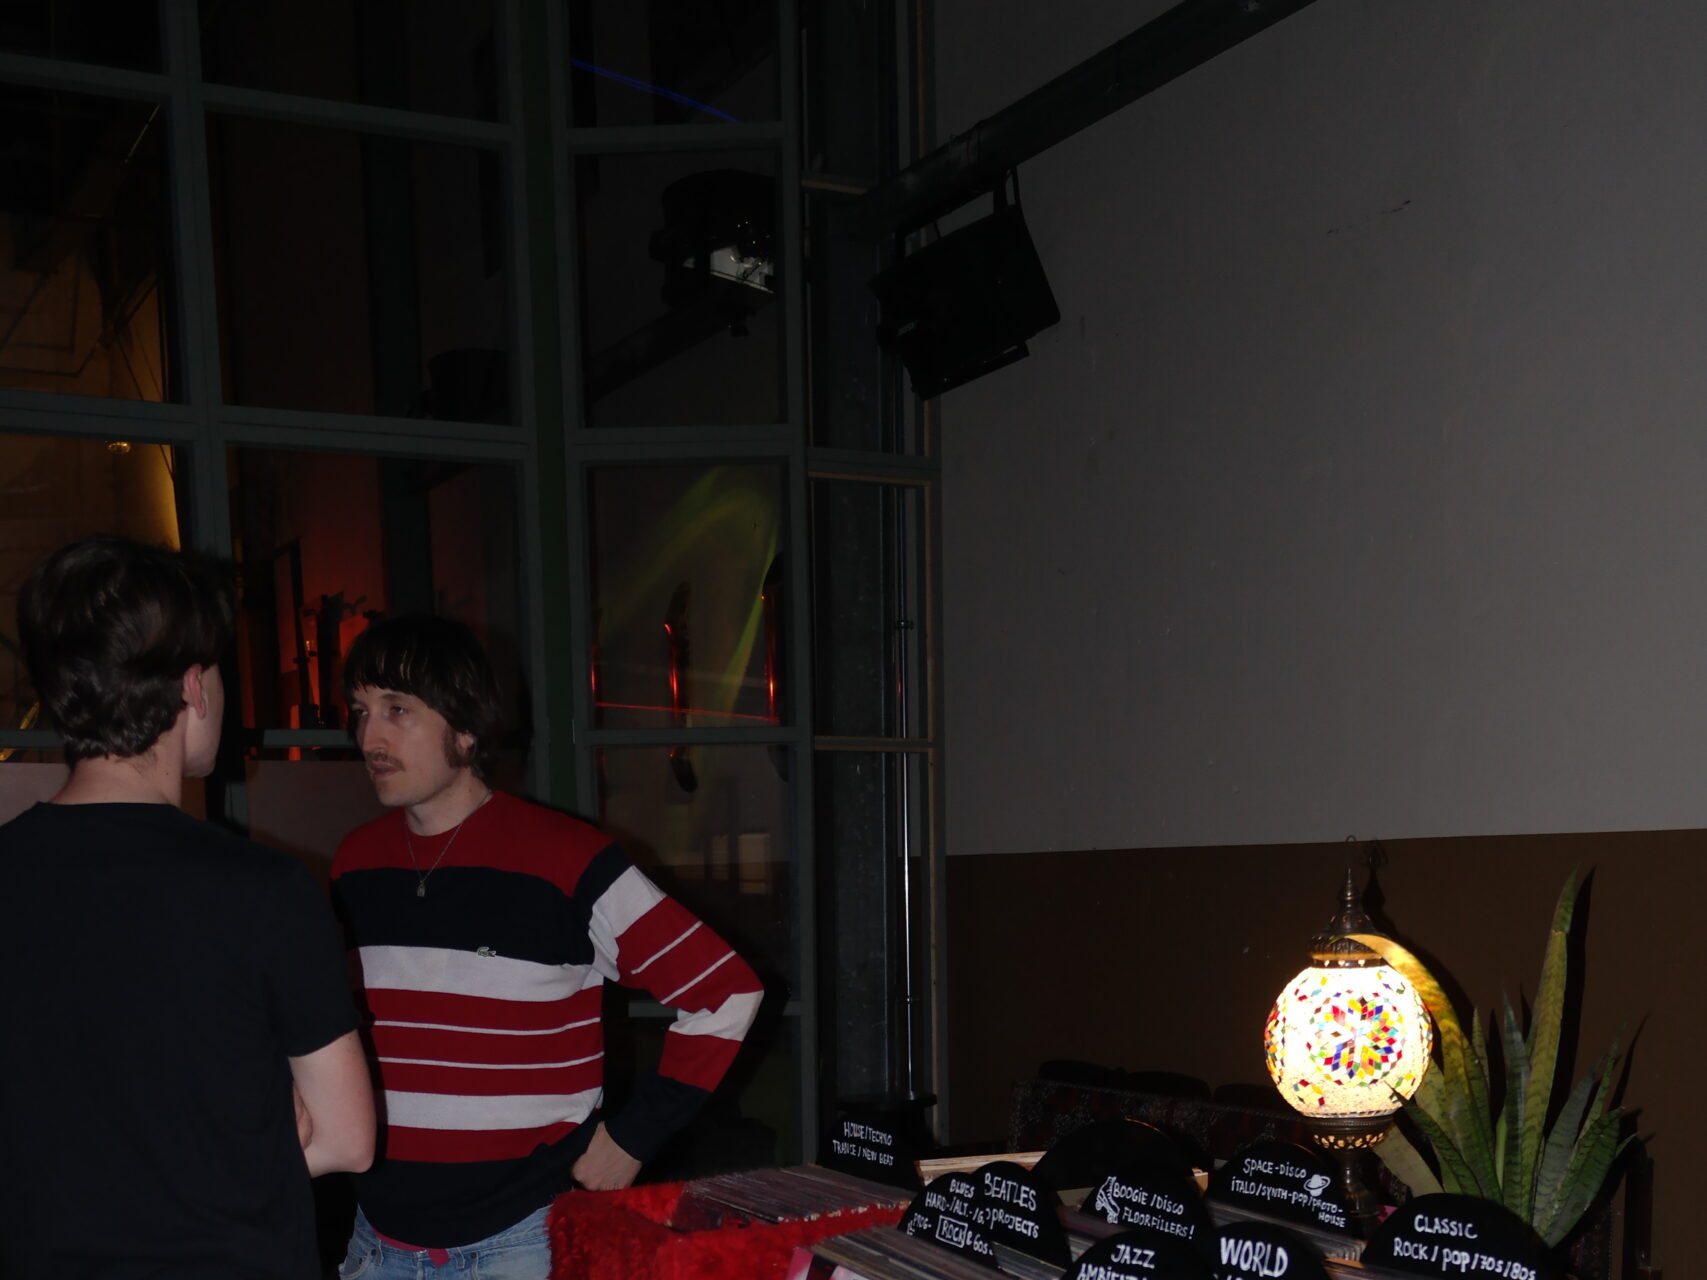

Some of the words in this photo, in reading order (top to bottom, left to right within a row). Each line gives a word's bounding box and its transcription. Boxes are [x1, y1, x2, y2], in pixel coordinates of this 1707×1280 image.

[984, 1172, 1037, 1212] BEATLES
[1413, 1214, 1478, 1240] CLASSIC
[1110, 1243, 1155, 1270] JAZZ
[1220, 1236, 1288, 1278] WORLD
